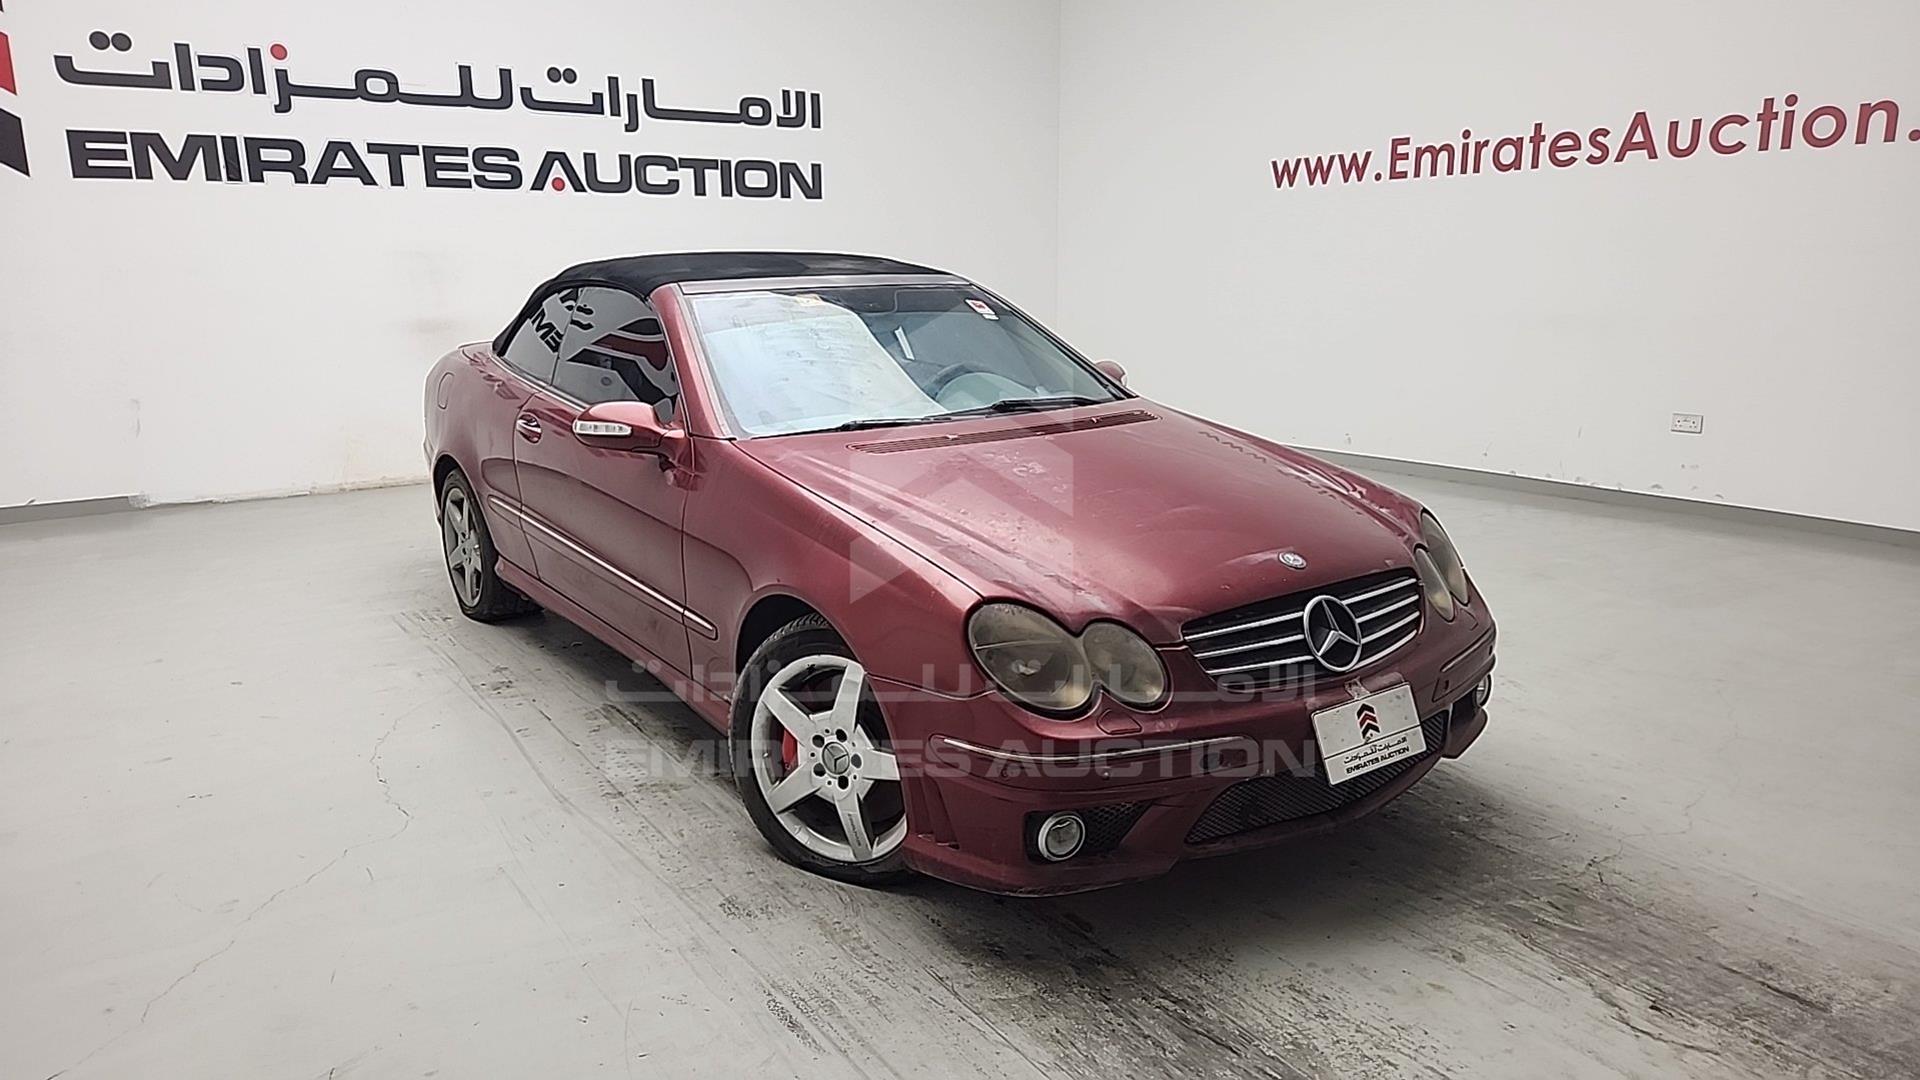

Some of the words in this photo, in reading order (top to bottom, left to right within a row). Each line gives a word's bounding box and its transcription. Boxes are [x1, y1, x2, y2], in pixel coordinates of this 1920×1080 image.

[53, 30, 513, 113] للمزادات
[66, 129, 523, 190] EMIRATES
[530, 151, 822, 200] AUCTION
[1271, 93, 1920, 189] www.EmiratesAuction.
[1346, 757, 1380, 774] EMIRATES
[1380, 745, 1410, 762] AUCTION
